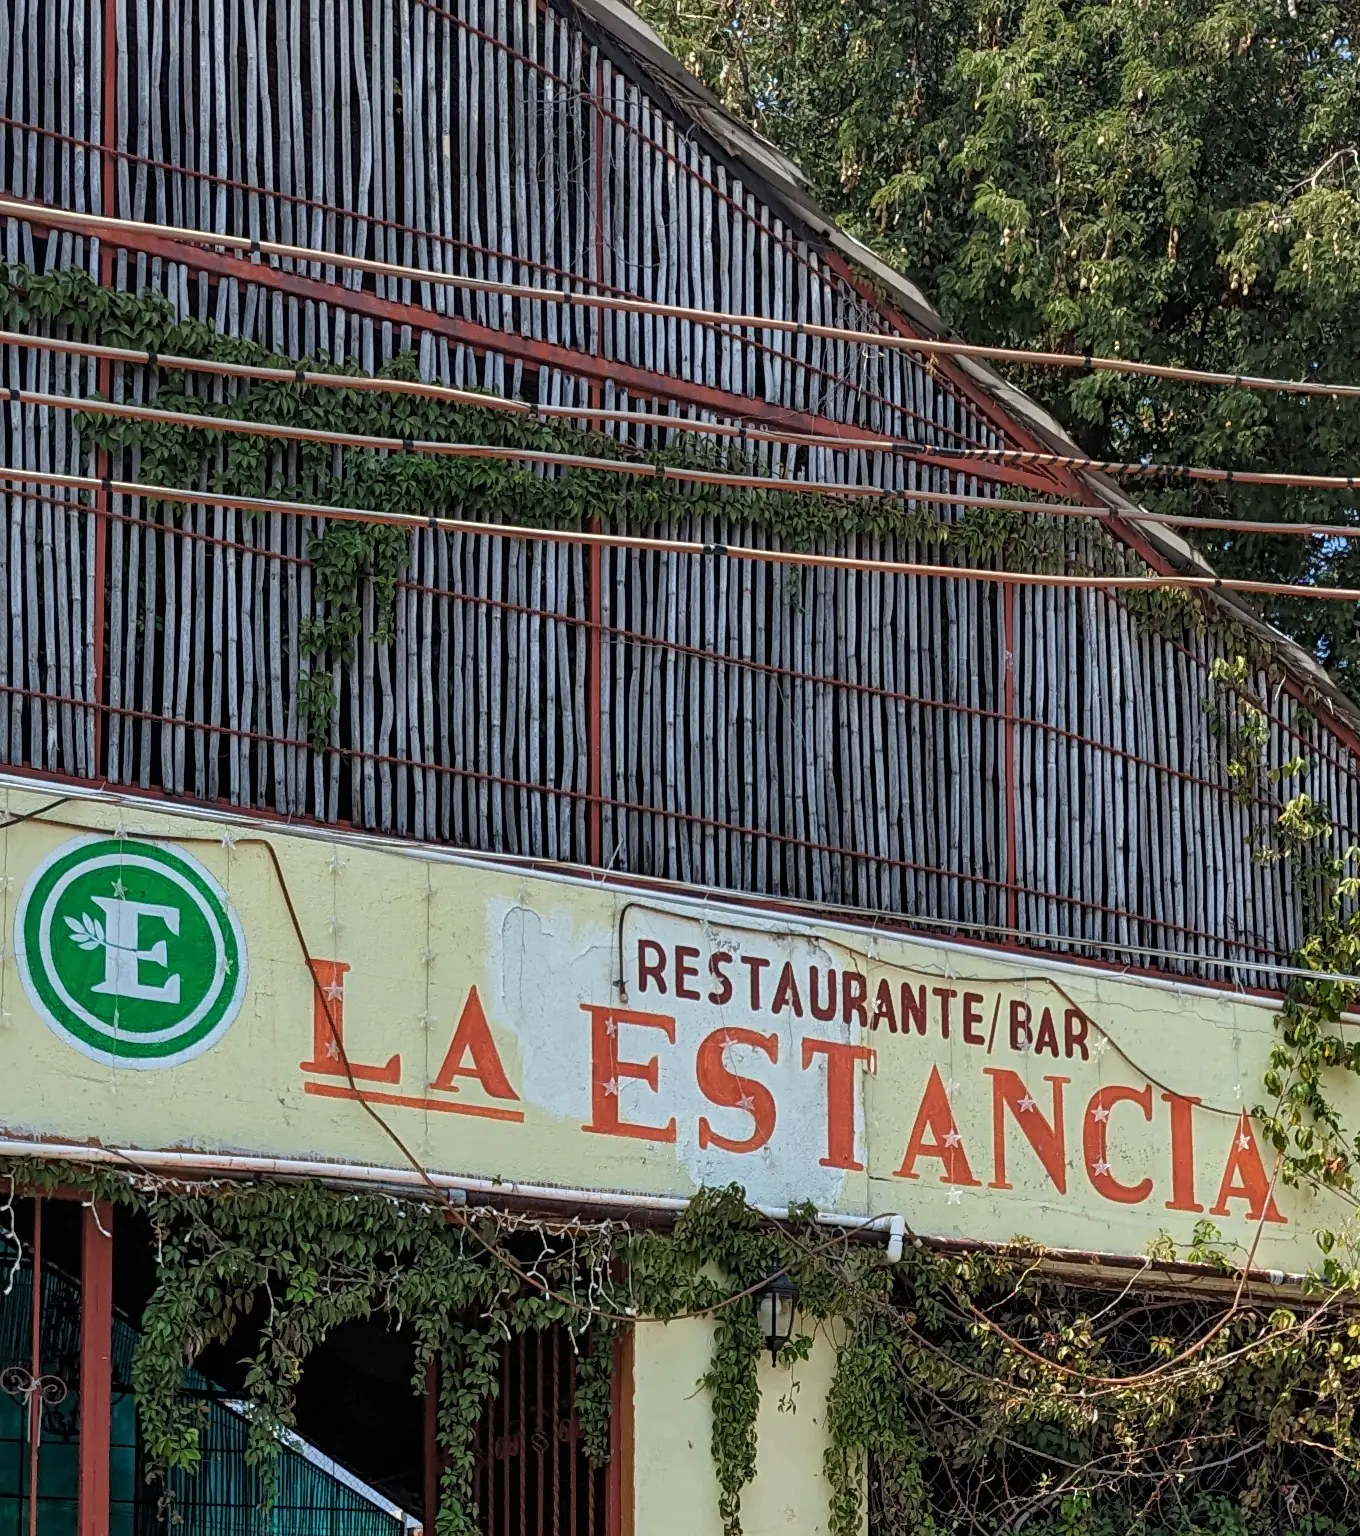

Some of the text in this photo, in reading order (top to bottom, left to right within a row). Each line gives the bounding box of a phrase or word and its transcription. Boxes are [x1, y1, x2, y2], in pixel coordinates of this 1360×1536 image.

[90, 896, 181, 1003] E
[637, 938, 1090, 1062] RESTAURANTE/BAR
[300, 958, 1288, 1224] LA ESTANCIA
